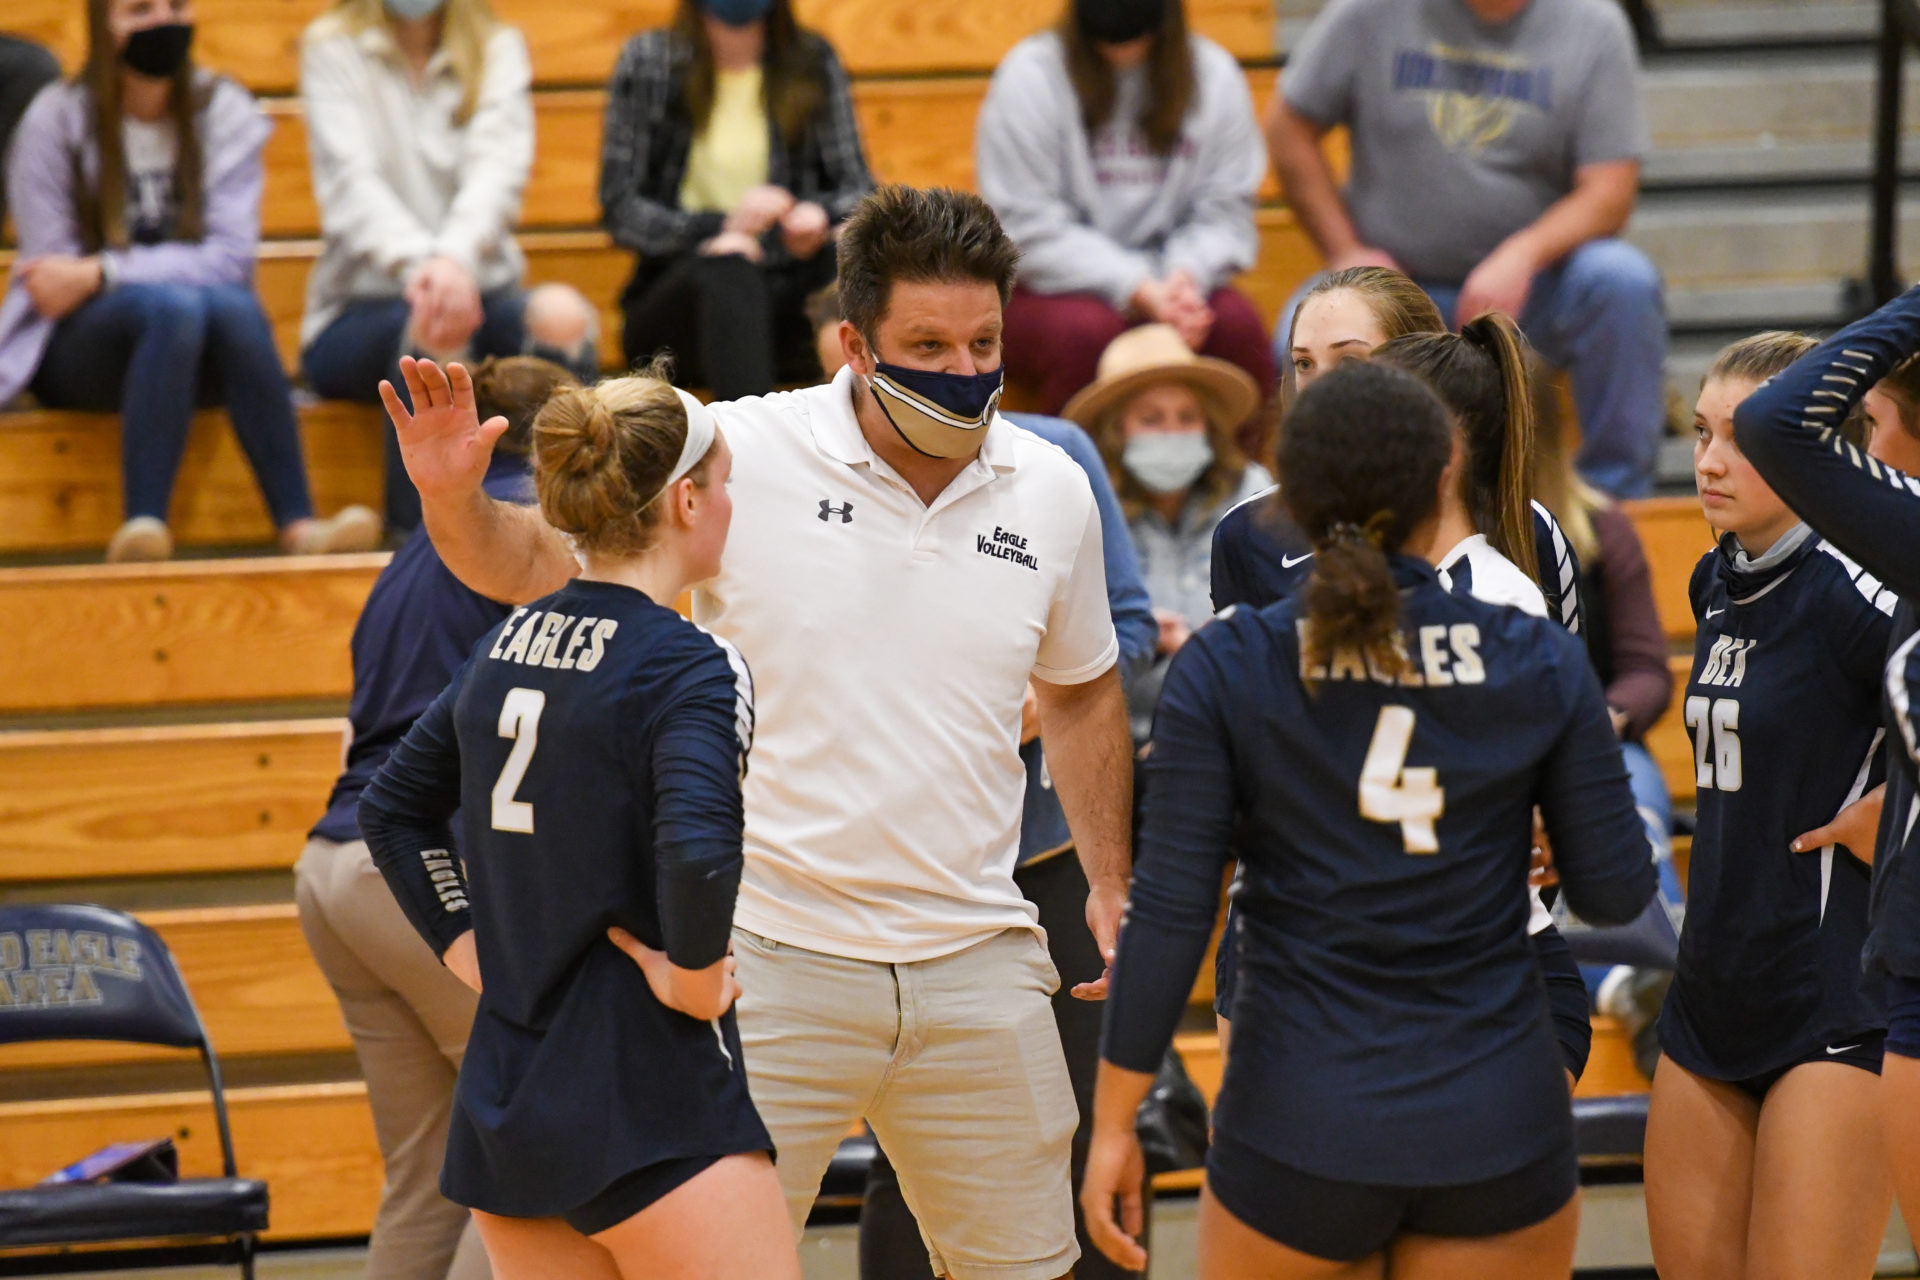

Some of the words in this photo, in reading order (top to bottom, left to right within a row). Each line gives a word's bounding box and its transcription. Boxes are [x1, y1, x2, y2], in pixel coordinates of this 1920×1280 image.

[977, 534, 1038, 571] VOLLEYBALL
[993, 526, 1028, 550] EAGLE
[489, 607, 618, 672] EAGLES
[1698, 633, 1757, 688] BEA
[491, 687, 546, 834] 2
[1686, 695, 1742, 792] 26
[1358, 704, 1445, 855] 4
[420, 848, 470, 912] EAGLES
[25, 928, 144, 982] EAGLE
